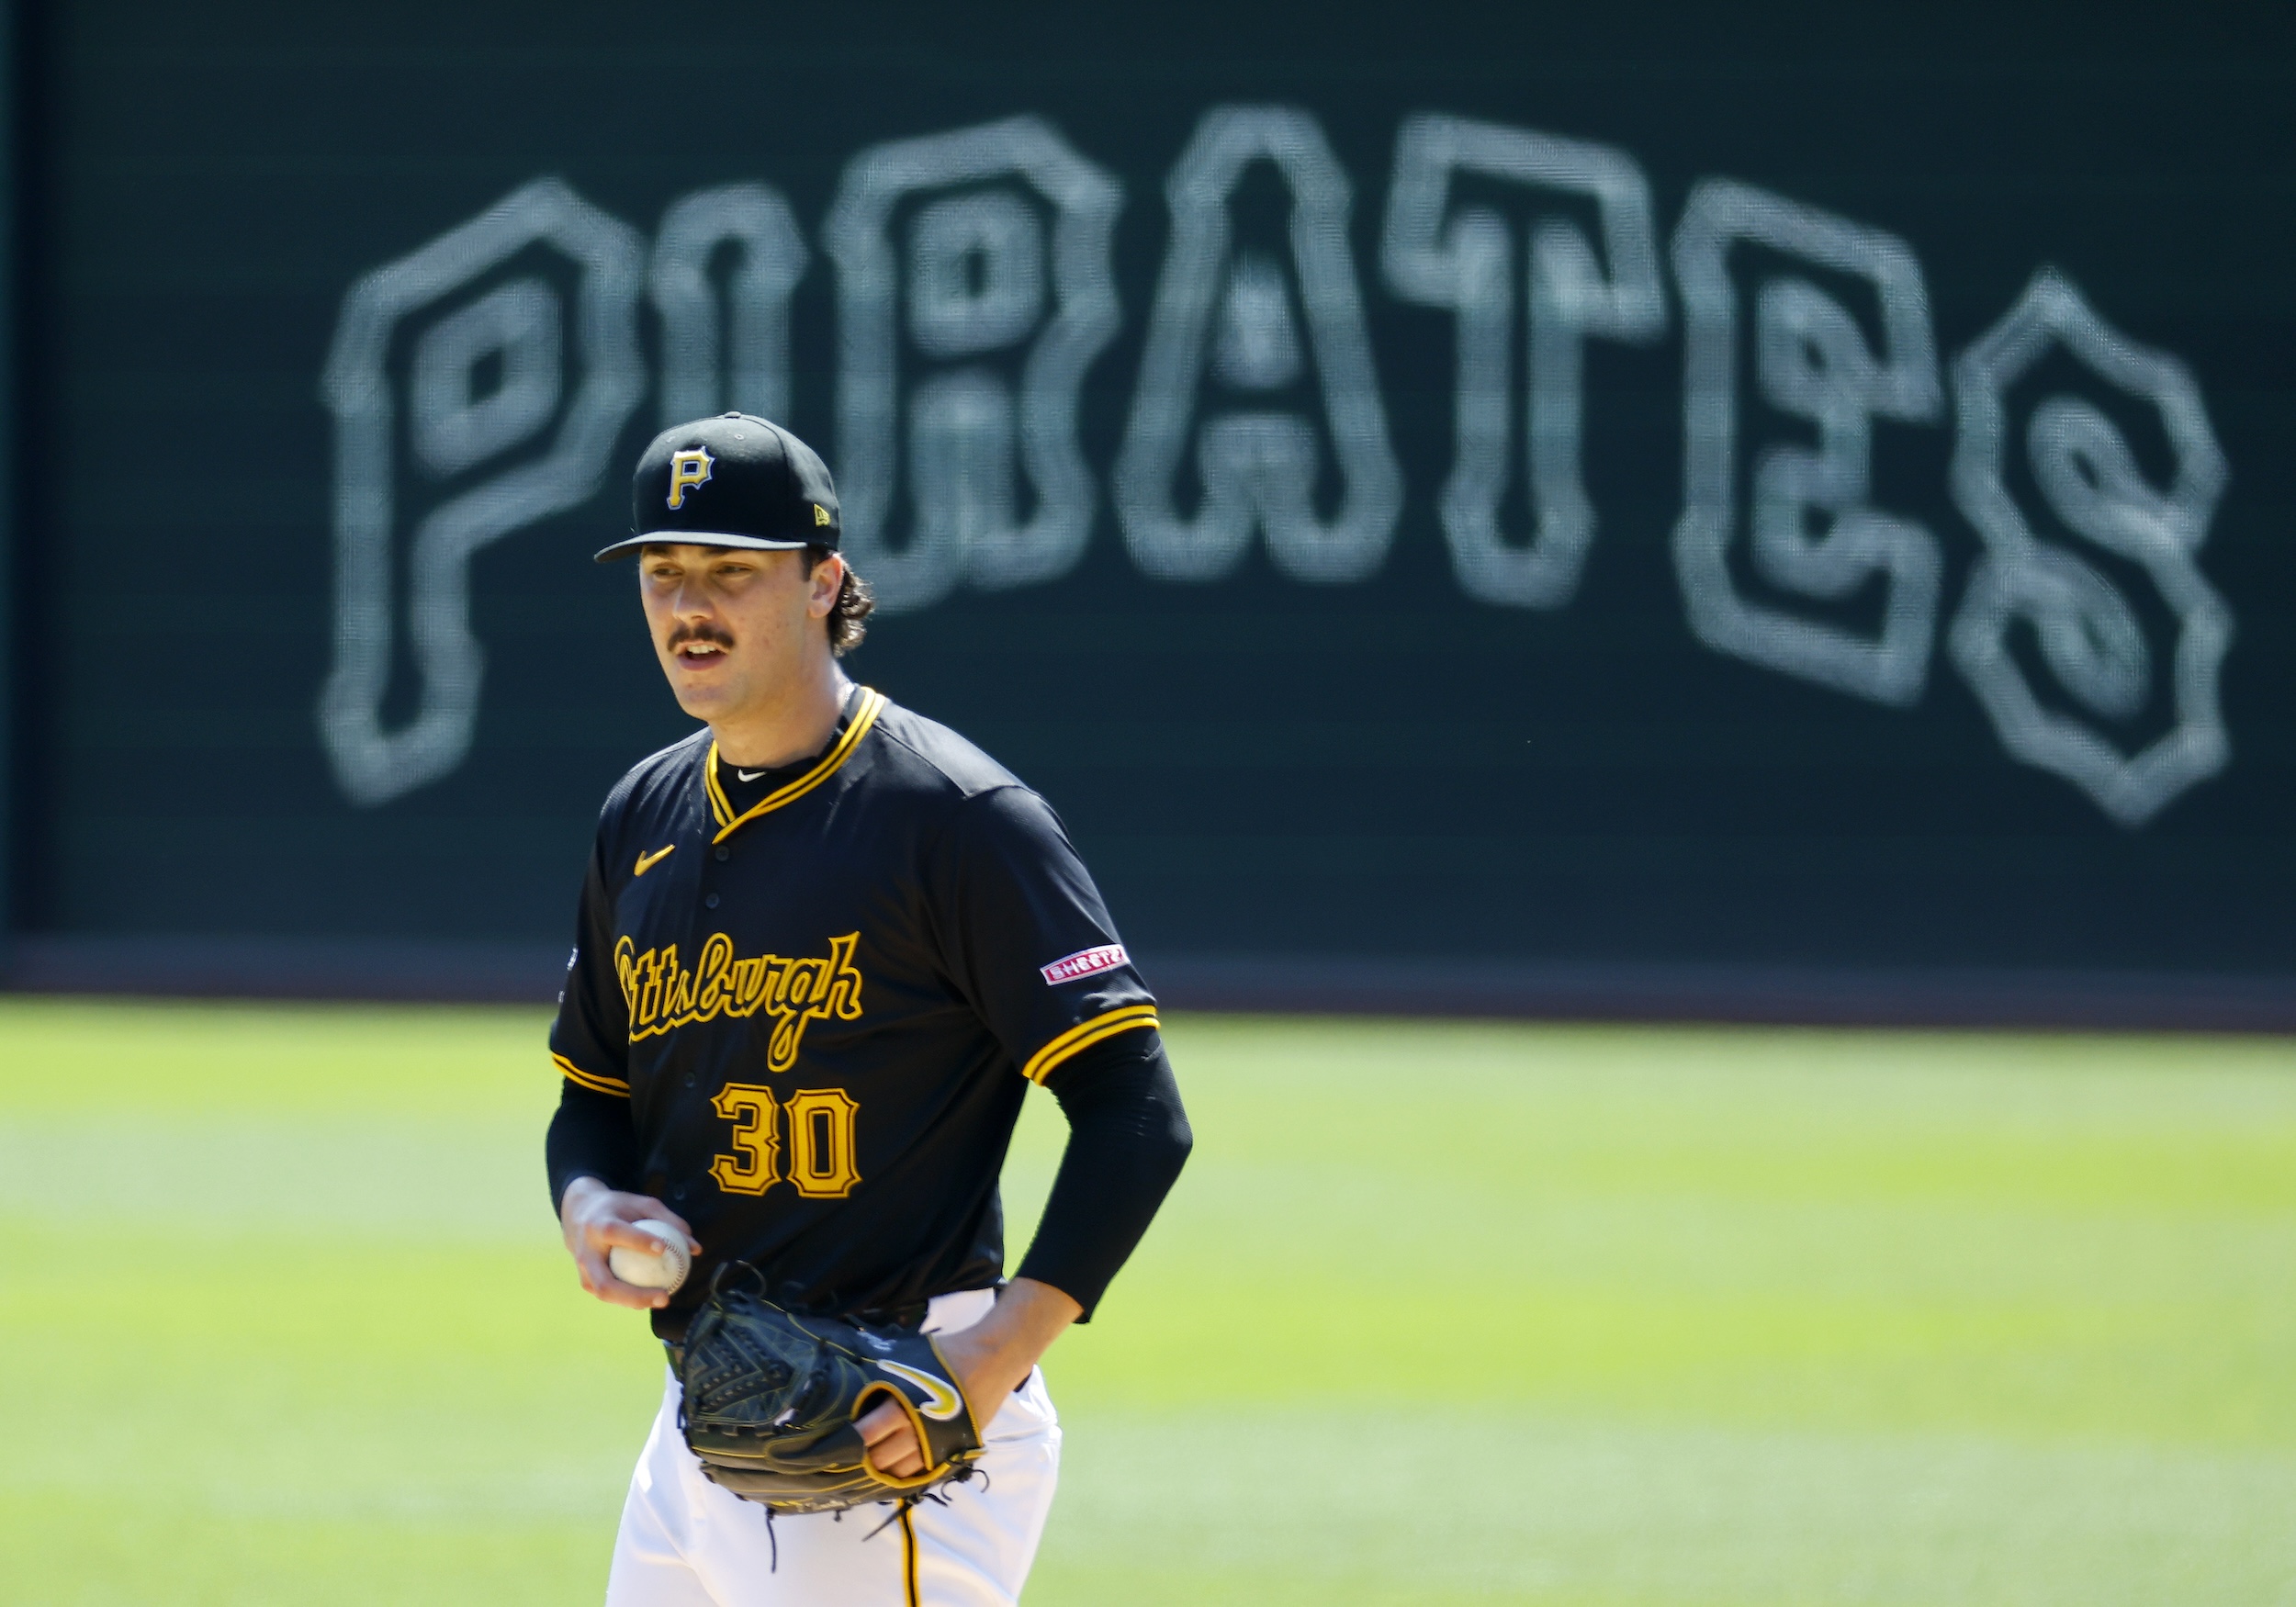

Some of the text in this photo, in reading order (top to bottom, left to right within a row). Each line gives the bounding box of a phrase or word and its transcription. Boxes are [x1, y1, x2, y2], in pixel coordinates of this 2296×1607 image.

[666, 444, 715, 510] P
[1048, 949, 1122, 980] SHEETZ
[708, 1082, 862, 1198] 30
